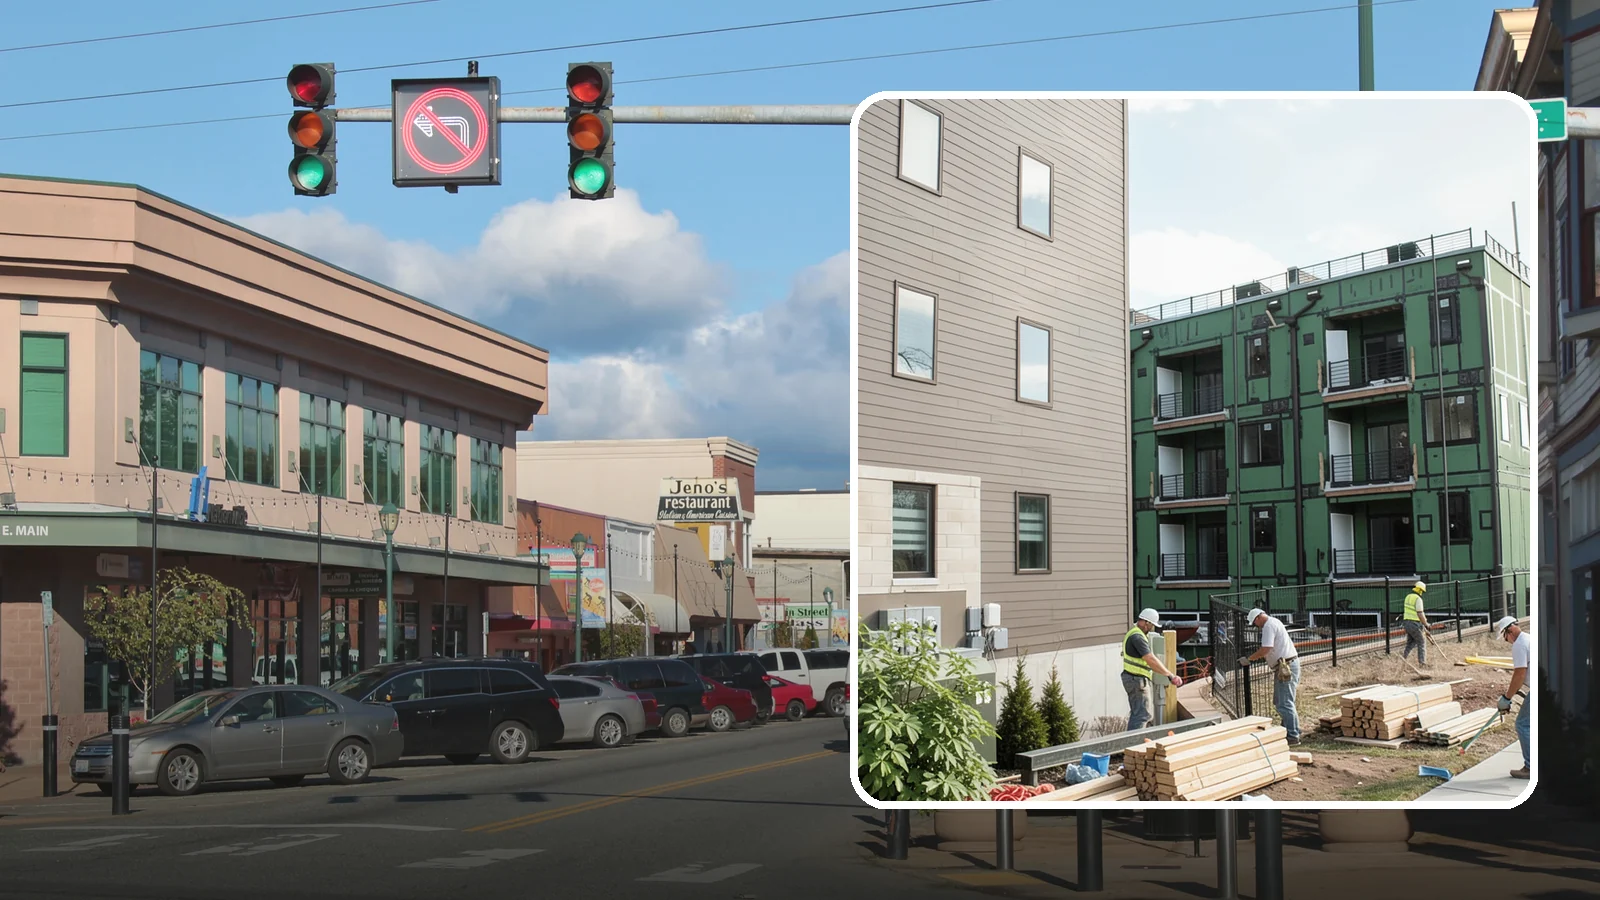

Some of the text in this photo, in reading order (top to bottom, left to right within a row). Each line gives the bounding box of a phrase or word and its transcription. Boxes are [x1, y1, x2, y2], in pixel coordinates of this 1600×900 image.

[670, 480, 727, 494] Jeno's
[665, 497, 731, 509] restaurant
[686, 510, 715, 519] American
[715, 510, 738, 519] Cuisine
[2, 525, 49, 536] E. MAIN
[797, 607, 828, 616] Street
